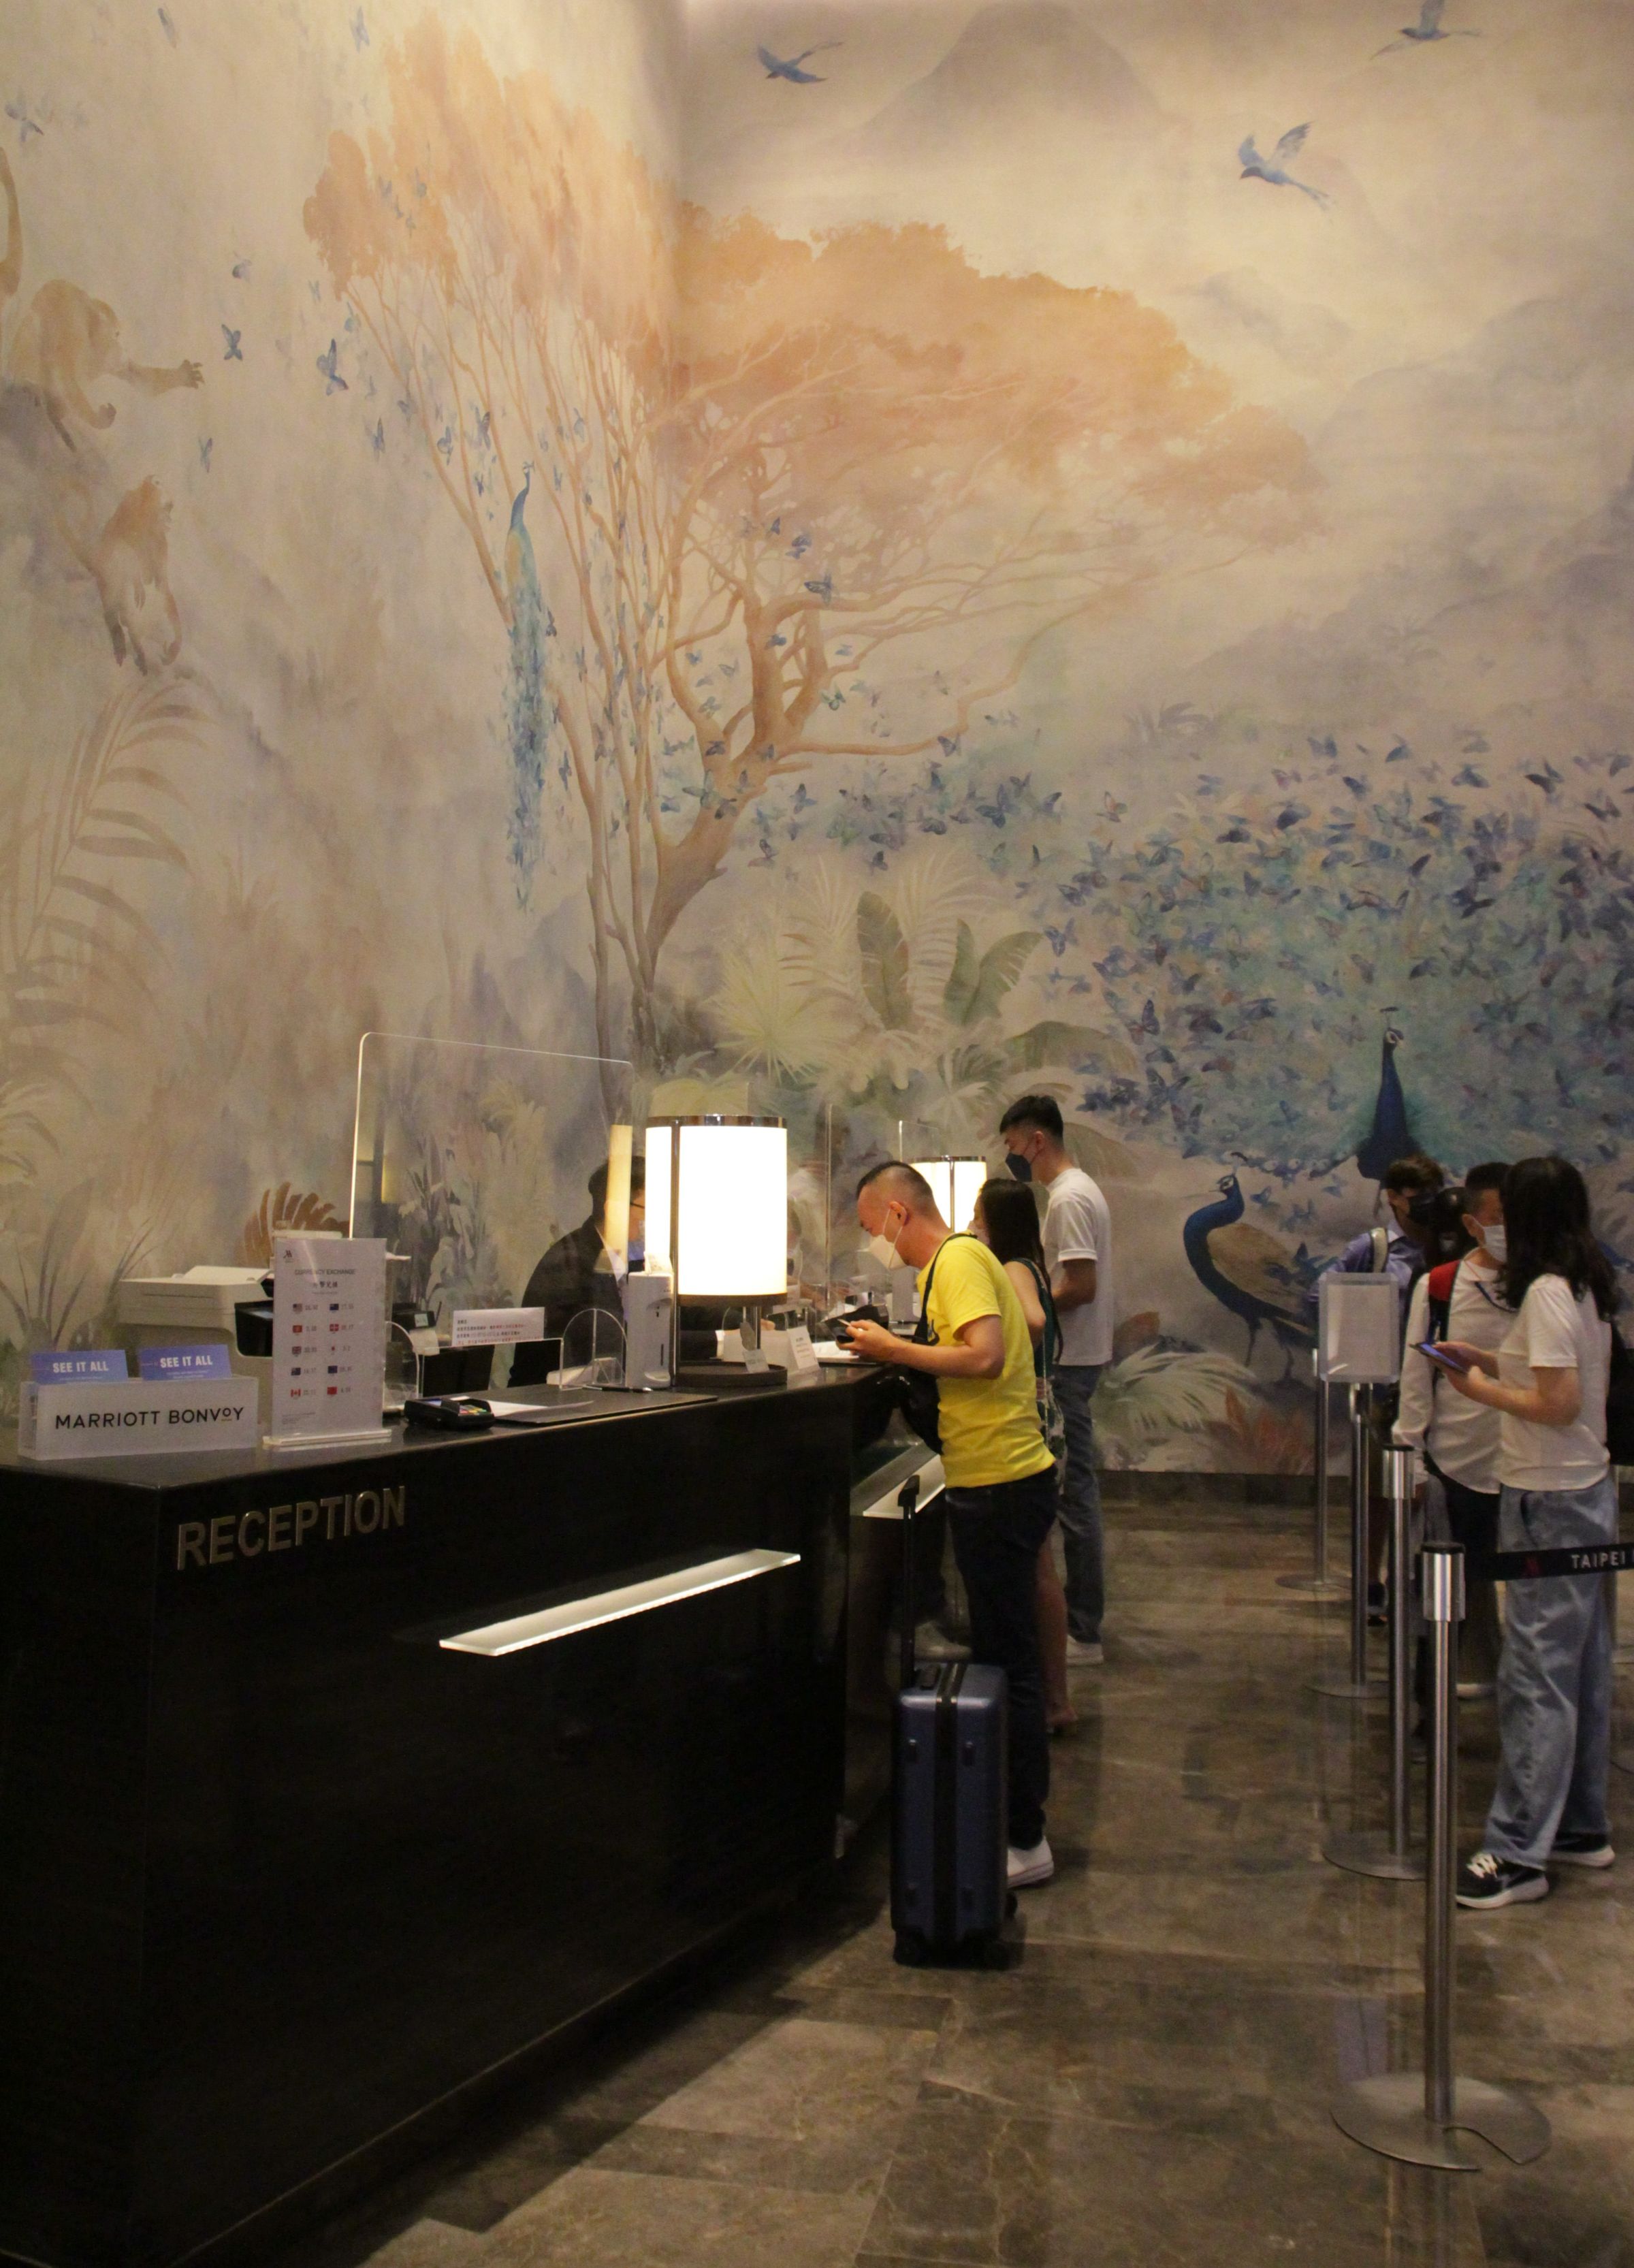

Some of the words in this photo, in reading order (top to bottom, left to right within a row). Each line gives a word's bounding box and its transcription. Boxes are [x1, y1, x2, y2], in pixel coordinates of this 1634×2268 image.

[52, 1362, 73, 1374] SEE
[76, 1361, 87, 1373] IT
[91, 1360, 110, 1373] ALL
[159, 1357, 180, 1369] SEE
[182, 1356, 192, 1367] IT
[195, 1355, 214, 1367] ALL
[55, 1411, 161, 1430] MARRIOTT
[177, 1485, 406, 1571] RECEPTION
[1571, 1550, 1627, 1569] TAIPEI
